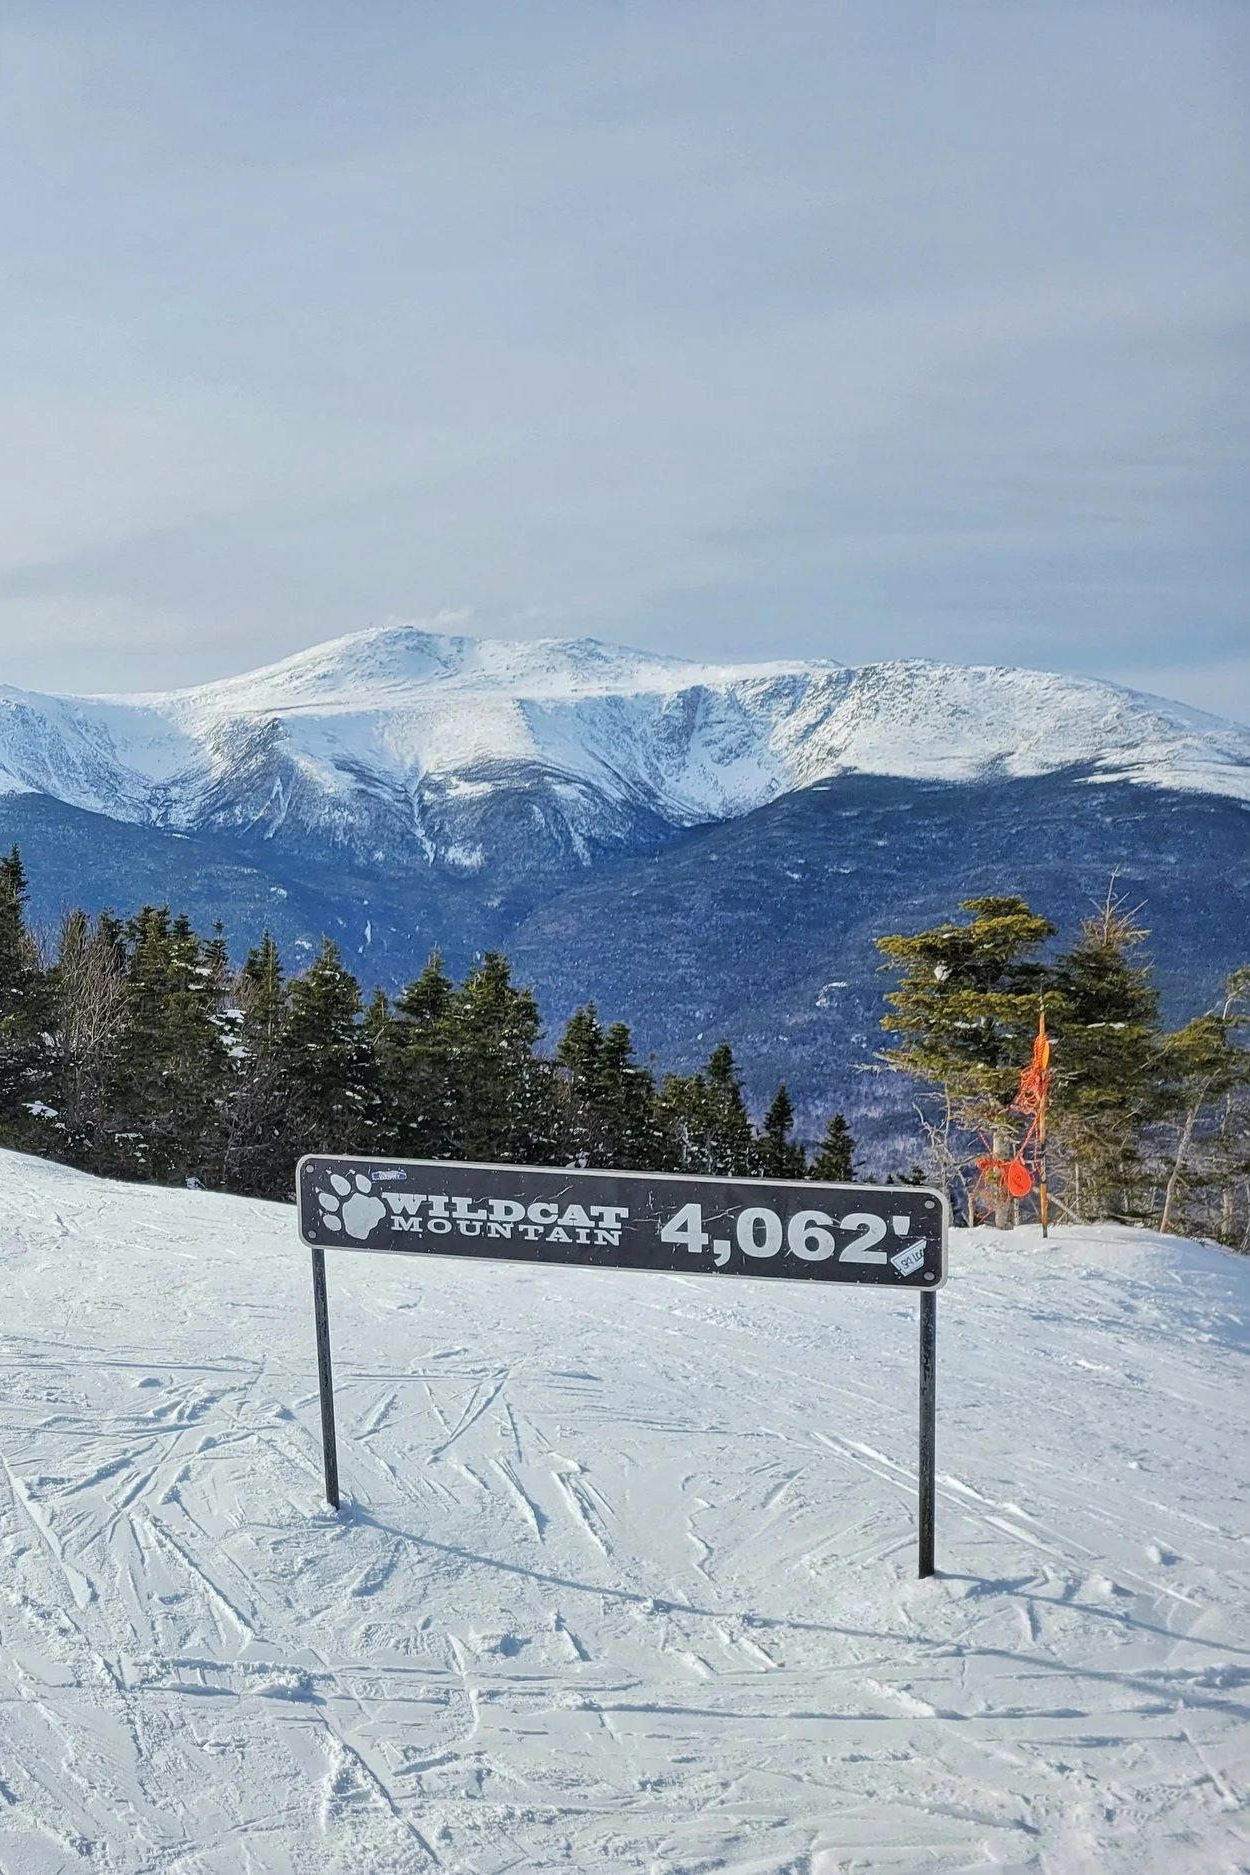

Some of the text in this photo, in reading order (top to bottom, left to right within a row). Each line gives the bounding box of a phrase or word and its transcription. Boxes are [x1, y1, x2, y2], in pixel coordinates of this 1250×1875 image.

[382, 1191, 629, 1229] WILDCAT
[390, 1215, 623, 1246] MOUNTAIN
[661, 1203, 911, 1267] 4,062'
